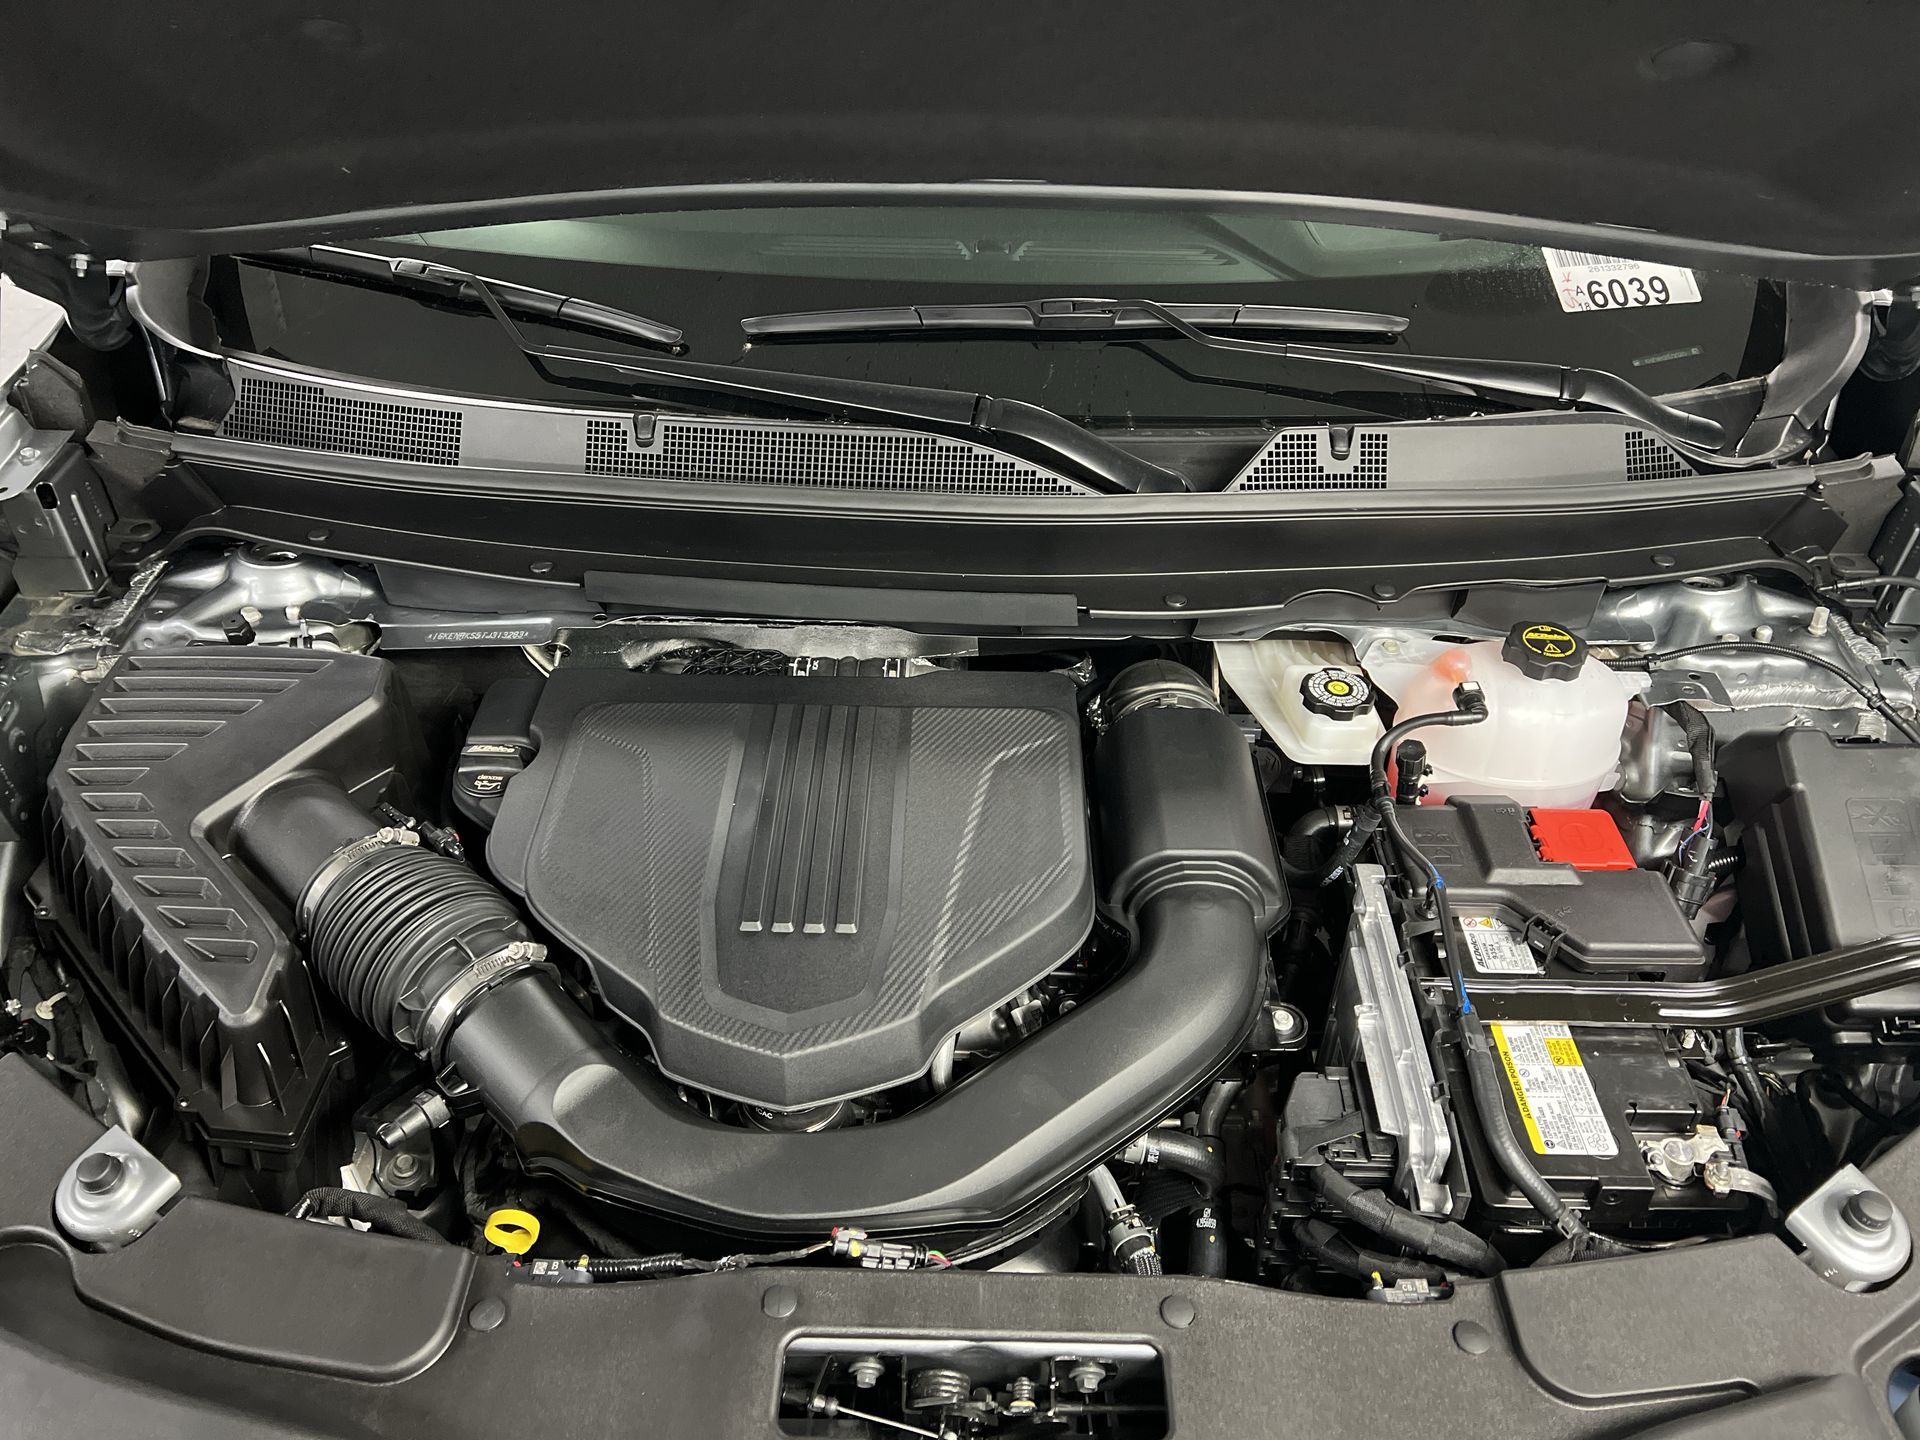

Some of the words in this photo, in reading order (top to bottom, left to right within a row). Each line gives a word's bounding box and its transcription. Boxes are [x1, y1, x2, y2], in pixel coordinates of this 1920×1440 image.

[1575, 285, 1585, 296] A
[1587, 276, 1670, 308] 6039
[1469, 933, 1486, 968] ACDelco
